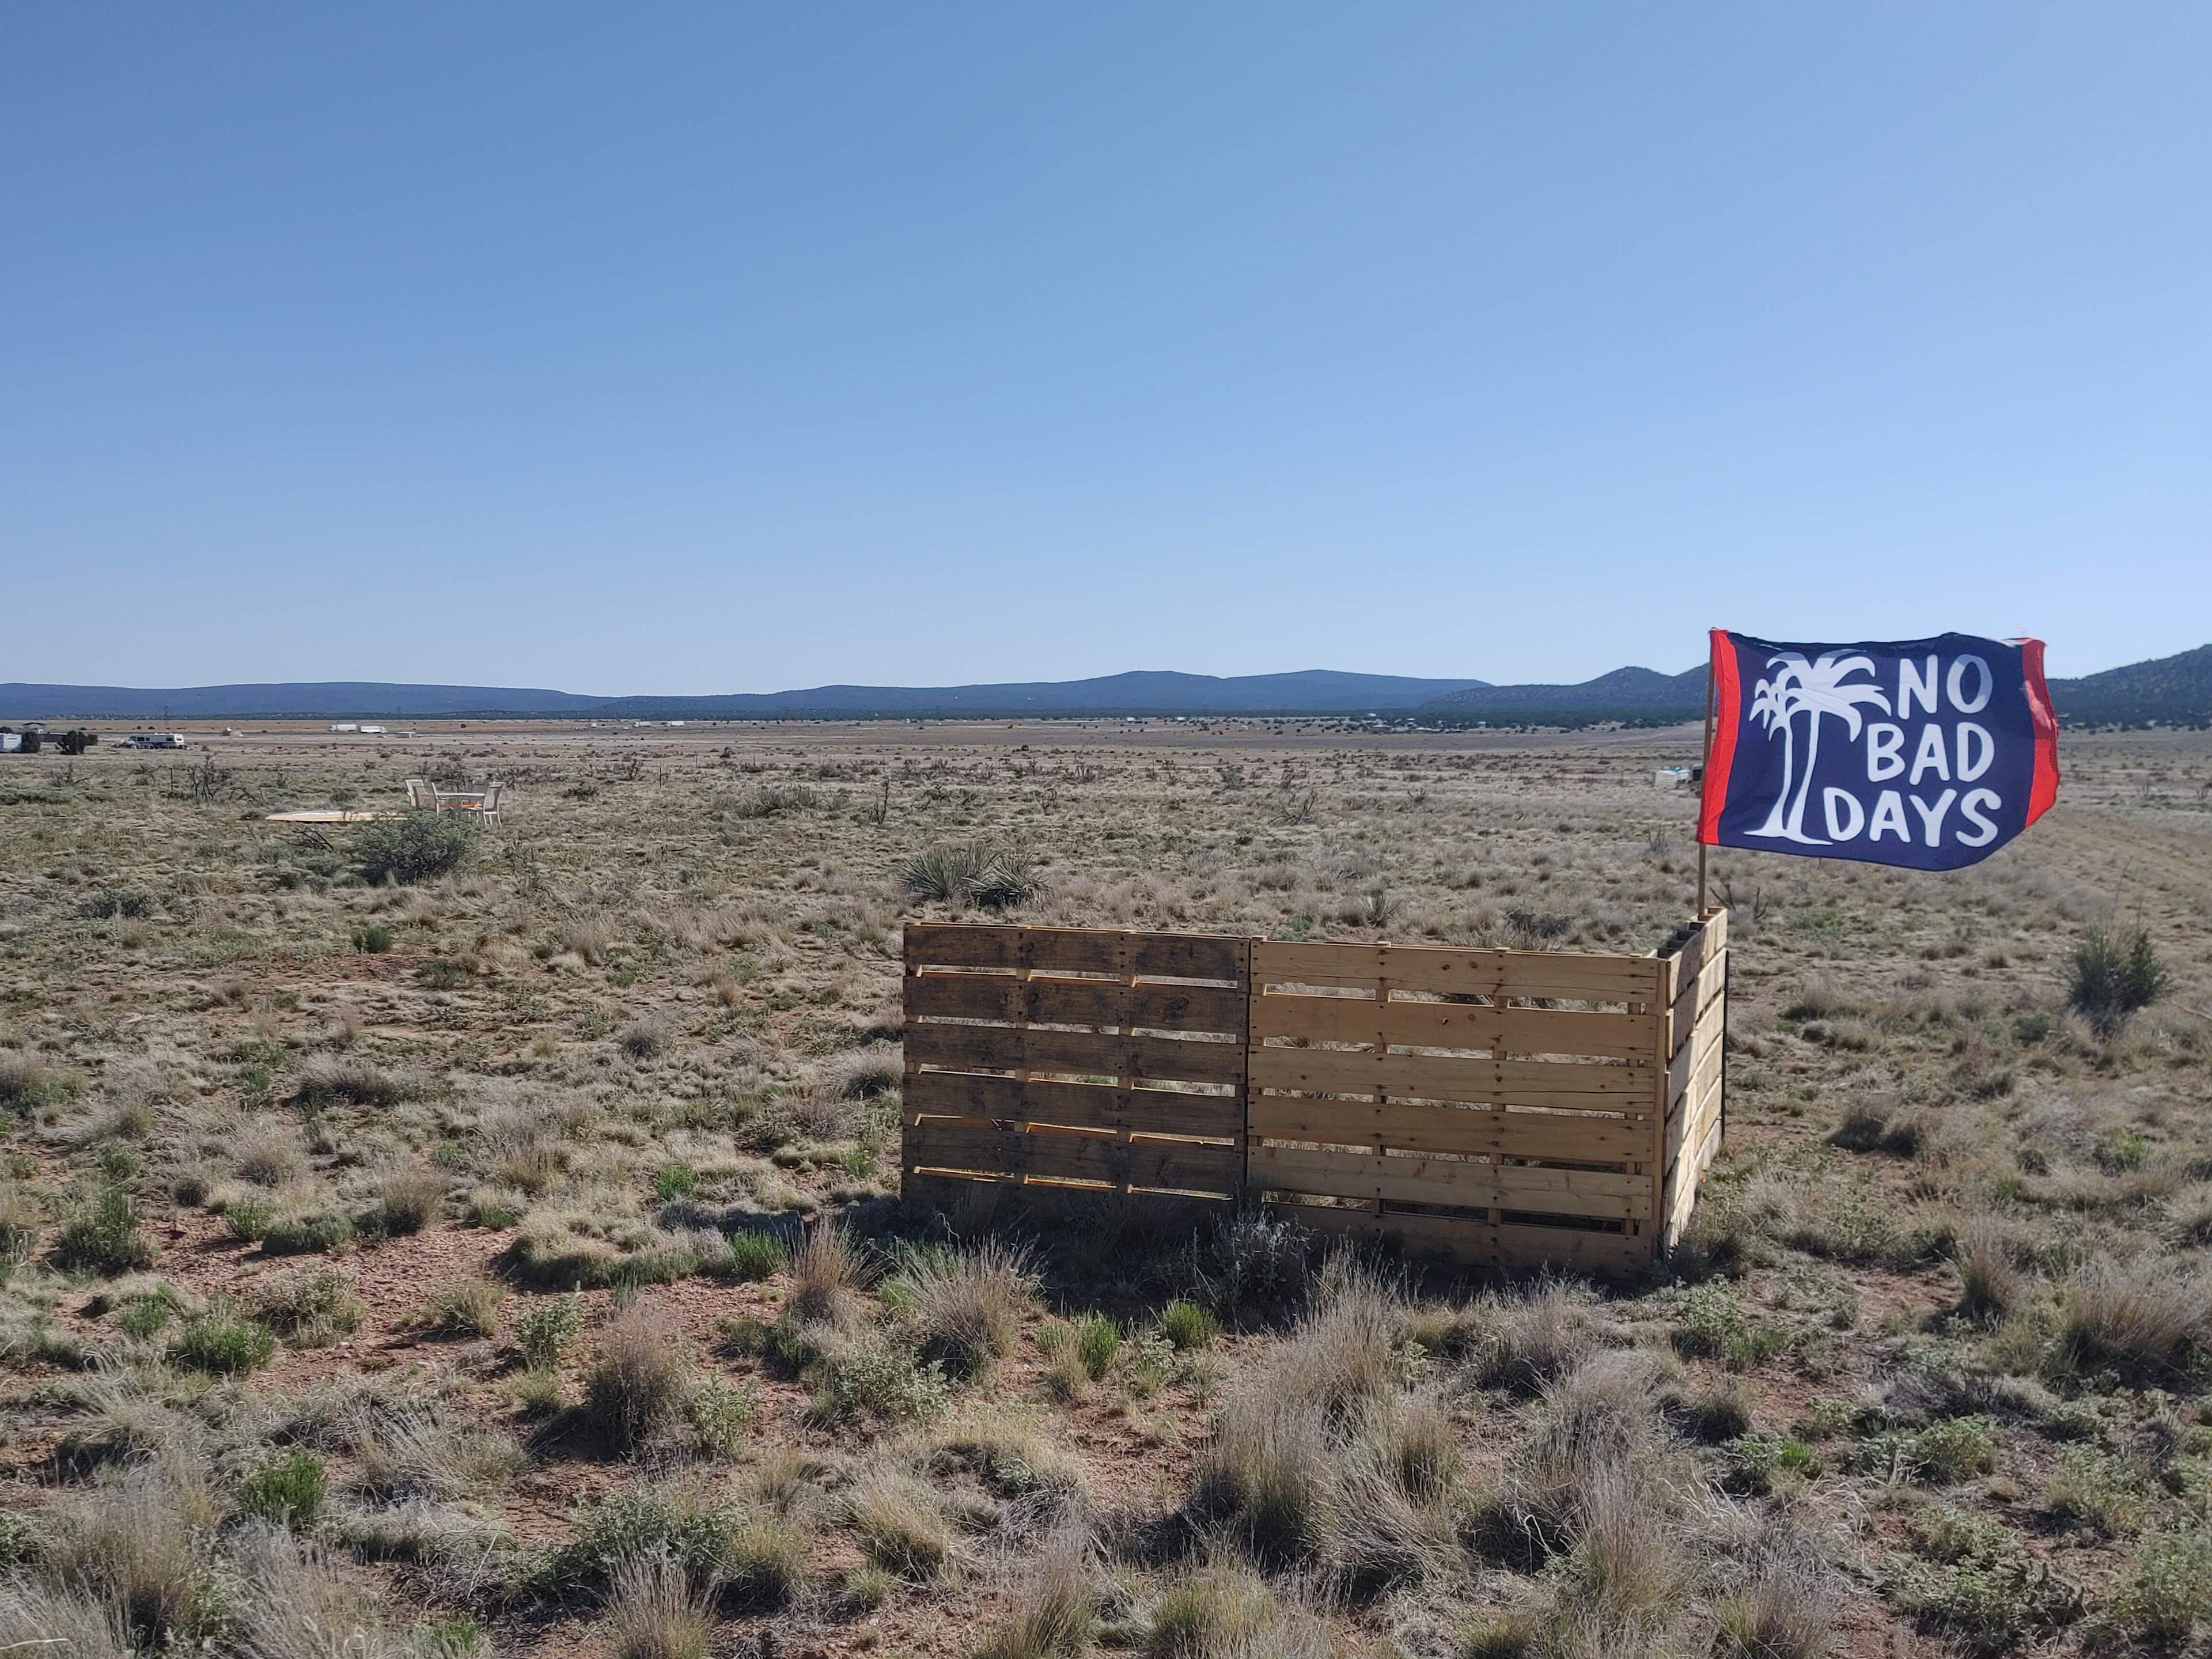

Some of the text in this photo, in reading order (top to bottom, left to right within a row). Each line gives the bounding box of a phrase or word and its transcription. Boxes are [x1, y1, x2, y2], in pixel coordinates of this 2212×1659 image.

[1897, 654, 1993, 719] NO
[1867, 722, 1995, 785] BAD
[1823, 787, 2002, 847] DAYS
